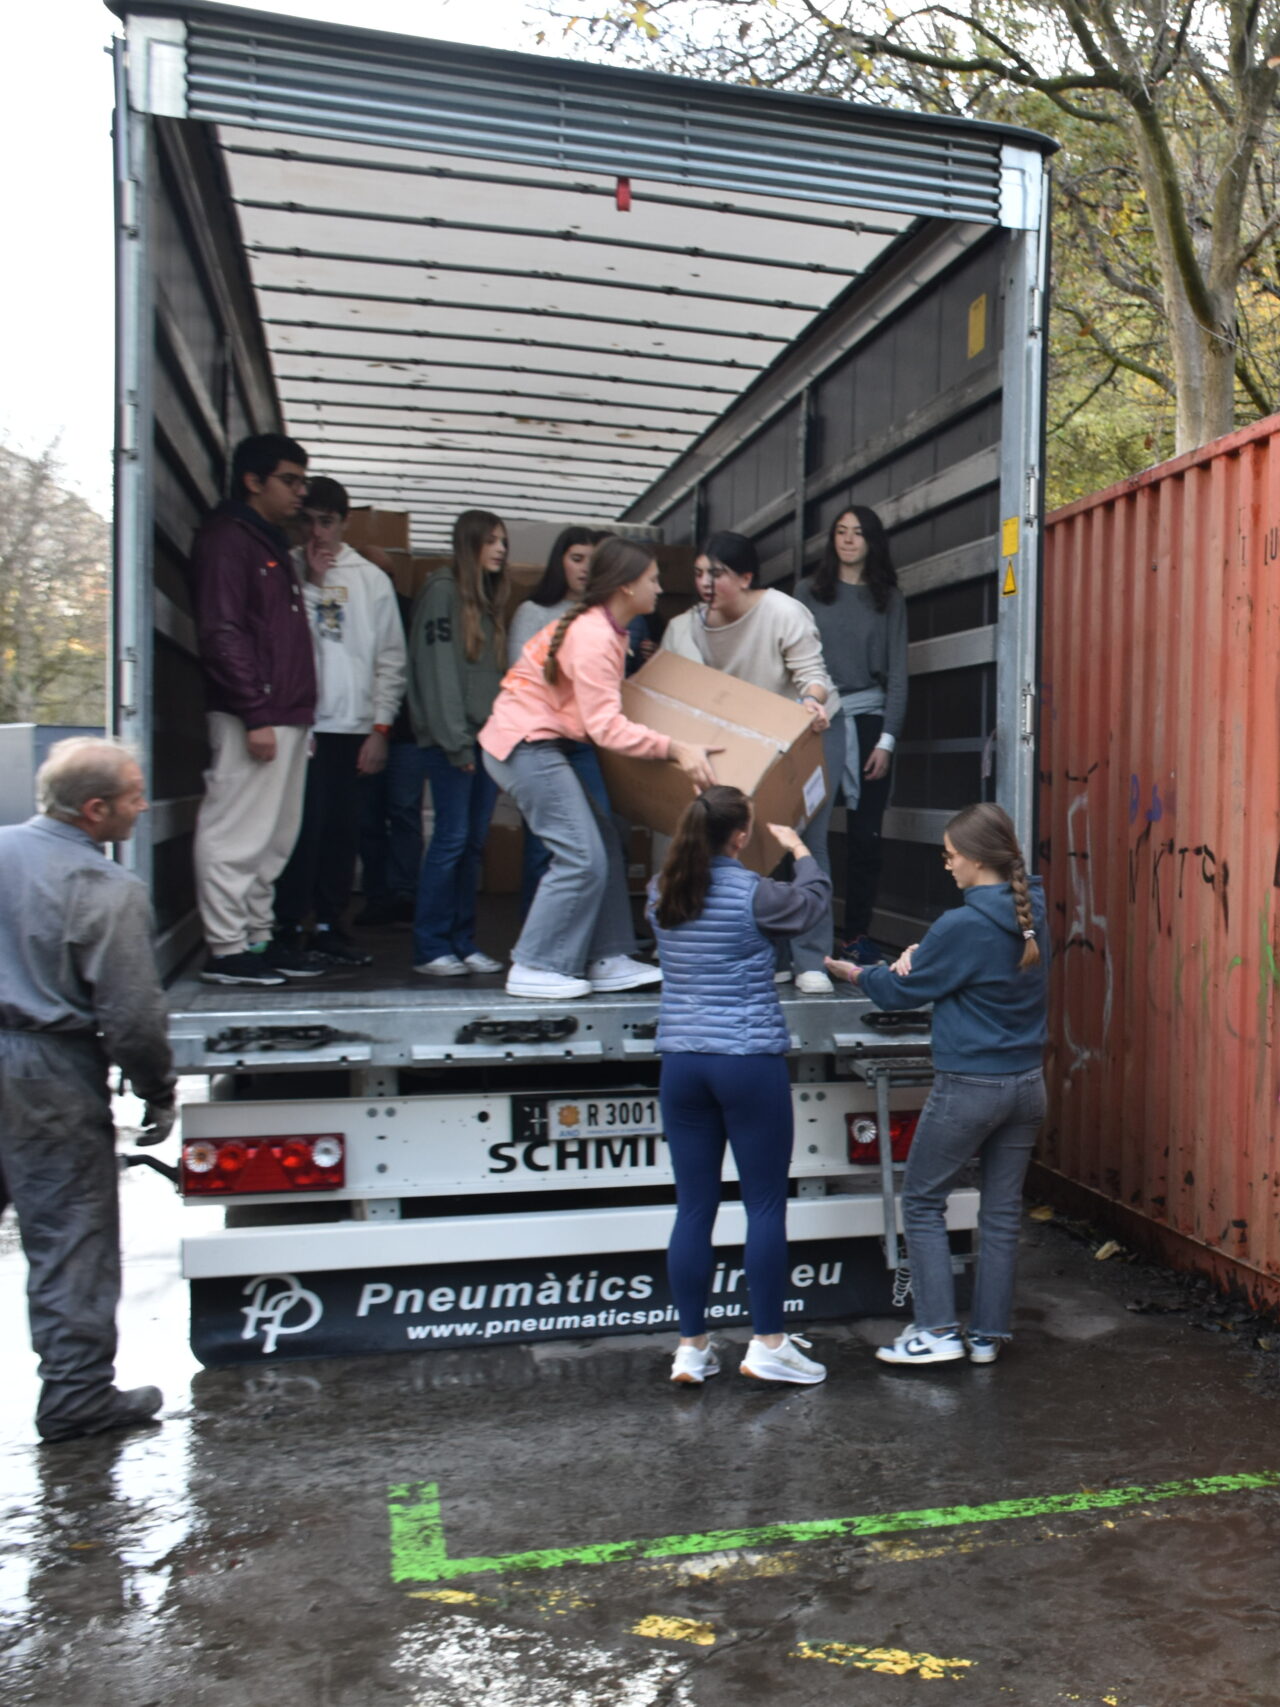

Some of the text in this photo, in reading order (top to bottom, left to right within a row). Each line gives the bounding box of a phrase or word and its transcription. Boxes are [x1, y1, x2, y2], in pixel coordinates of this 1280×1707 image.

[587, 1101, 656, 1126] R 3001
[356, 1270, 655, 1318] Pneumàtics
